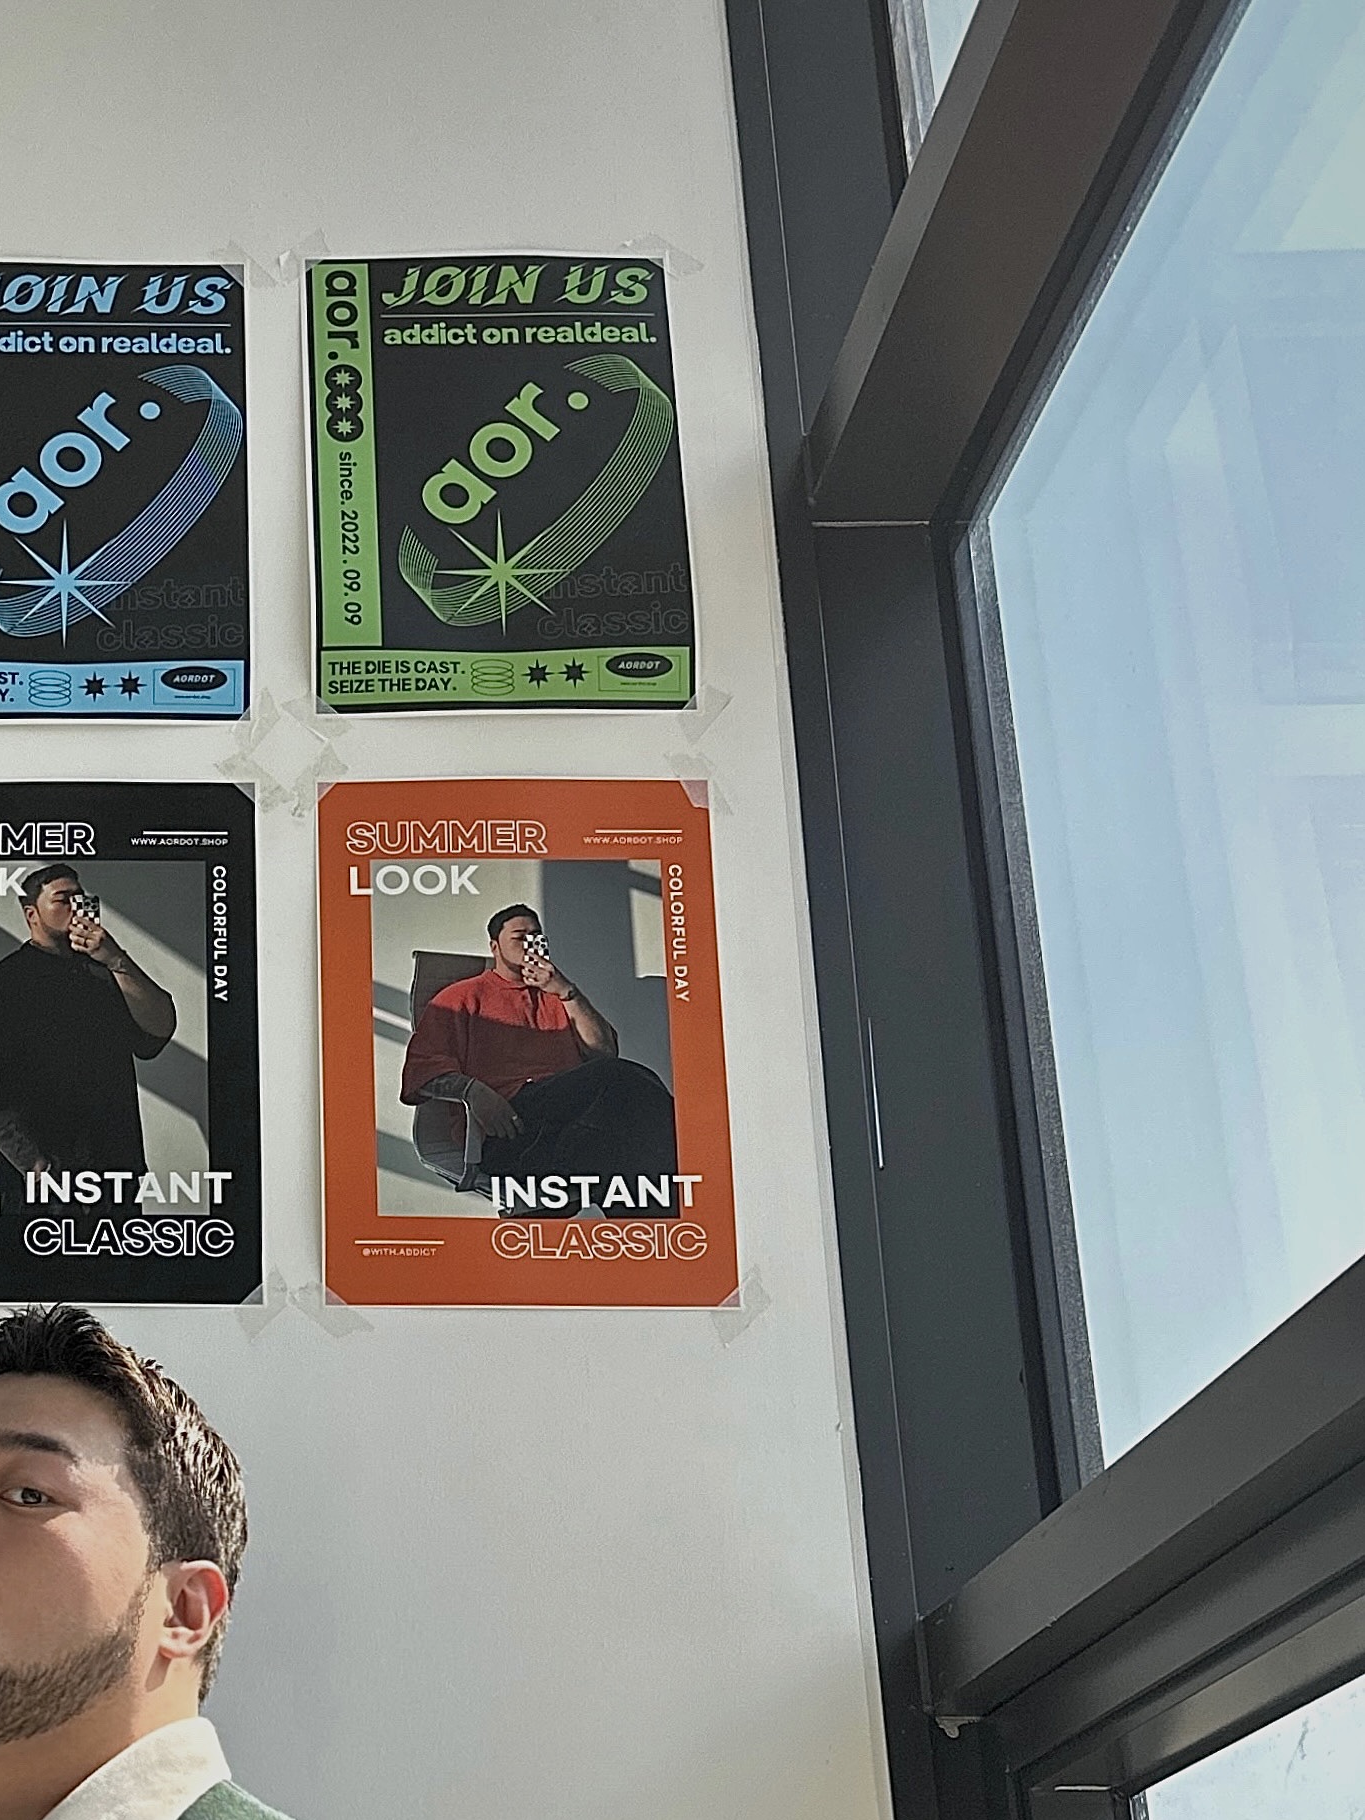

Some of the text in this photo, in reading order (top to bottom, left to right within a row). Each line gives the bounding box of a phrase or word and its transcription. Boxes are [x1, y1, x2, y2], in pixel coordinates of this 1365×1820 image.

[134, 273, 233, 316] US
[381, 263, 656, 309] JOIN US
[58, 335, 95, 354] on
[101, 331, 232, 355] realdeal.
[384, 322, 657, 345] addict on realdeal.
[339, 451, 357, 506] since.
[106, 575, 245, 611] nstant
[544, 561, 687, 599] nstant
[344, 601, 362, 626] 09
[537, 600, 689, 639] classic
[96, 614, 245, 651] classic
[172, 674, 216, 683] AORDOT
[328, 660, 465, 676] THE DIE IS CAST.
[617, 660, 661, 670] AORDOT
[328, 677, 457, 694] SEIZE THE DAY.
[346, 820, 548, 855] SUMMER
[348, 865, 480, 897] LOOK
[212, 865, 229, 1002] COLORFUL DAY
[668, 864, 691, 1002] COLORFUL DAY
[25, 1171, 233, 1205] INSTANT
[490, 1174, 703, 1209] INSTANT
[24, 1219, 235, 1257] CLASSIC
[491, 1222, 708, 1261] CLASSIC
